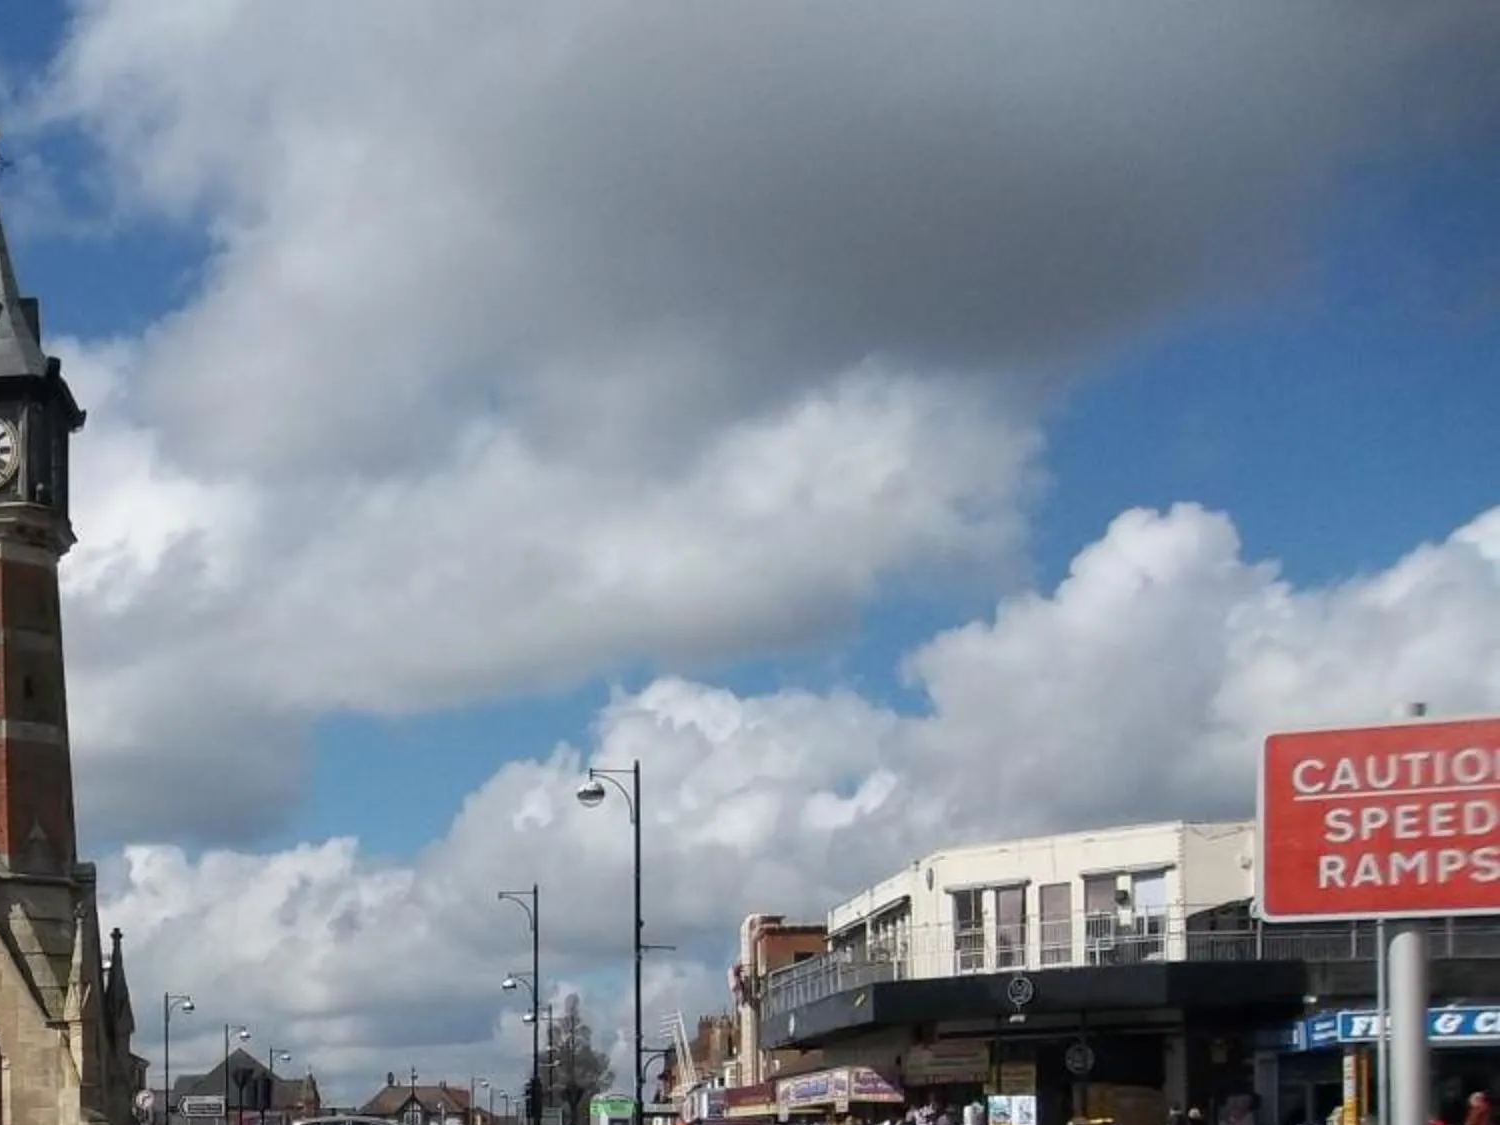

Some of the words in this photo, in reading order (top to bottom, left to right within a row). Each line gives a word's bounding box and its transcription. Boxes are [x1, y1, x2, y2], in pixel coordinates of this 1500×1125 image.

[1324, 800, 1499, 842] SPEED
[1317, 846, 1500, 889] RAMPS
[1434, 1013, 1462, 1033] &
[1474, 1011, 1500, 1033] C
